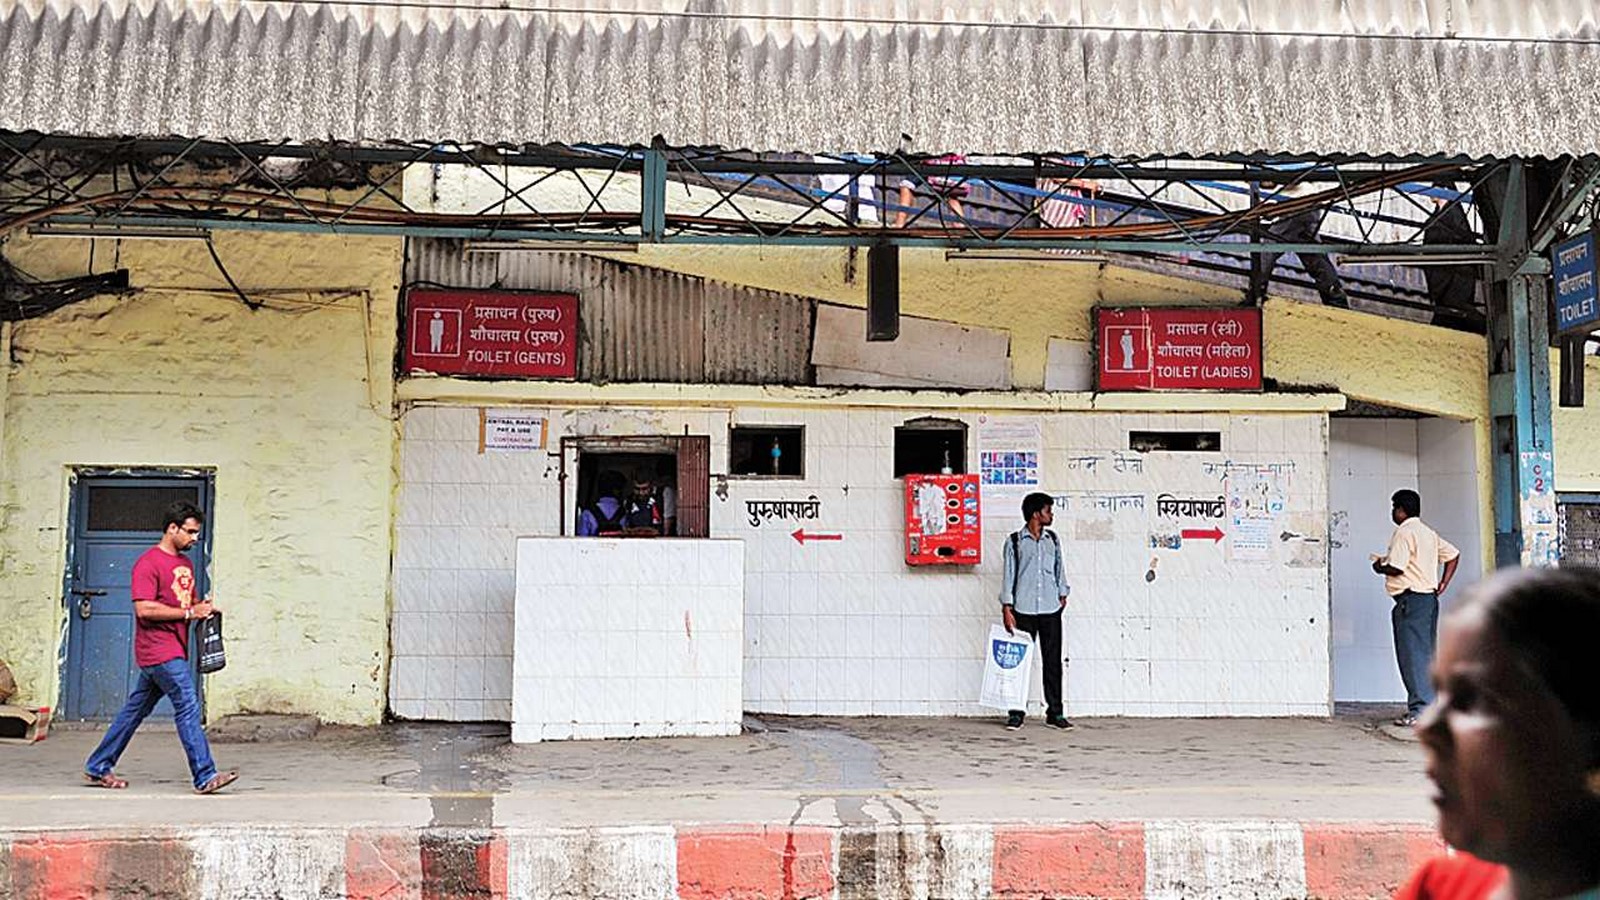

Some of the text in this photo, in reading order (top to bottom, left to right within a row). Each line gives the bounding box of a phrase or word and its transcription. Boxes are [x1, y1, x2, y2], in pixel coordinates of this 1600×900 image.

[1558, 242, 1588, 267] प्रसाधन
[474, 305, 562, 324] प्रसाधन (पुरुष)
[1559, 297, 1595, 323] TOILET
[469, 324, 565, 346] शौचालय (पुरुष)
[1166, 319, 1243, 338] प्रसाधन (स्त्री)
[467, 350, 566, 366] TOILET (GENTS)
[1157, 341, 1251, 359] शौचालय (महिला)
[1156, 366, 1253, 380] TOILET (LADIES)
[1535, 477, 1544, 492] 2
[745, 494, 821, 528] पुरुषांसाठी
[1156, 493, 1227, 521] स्त्रियांसाठी
